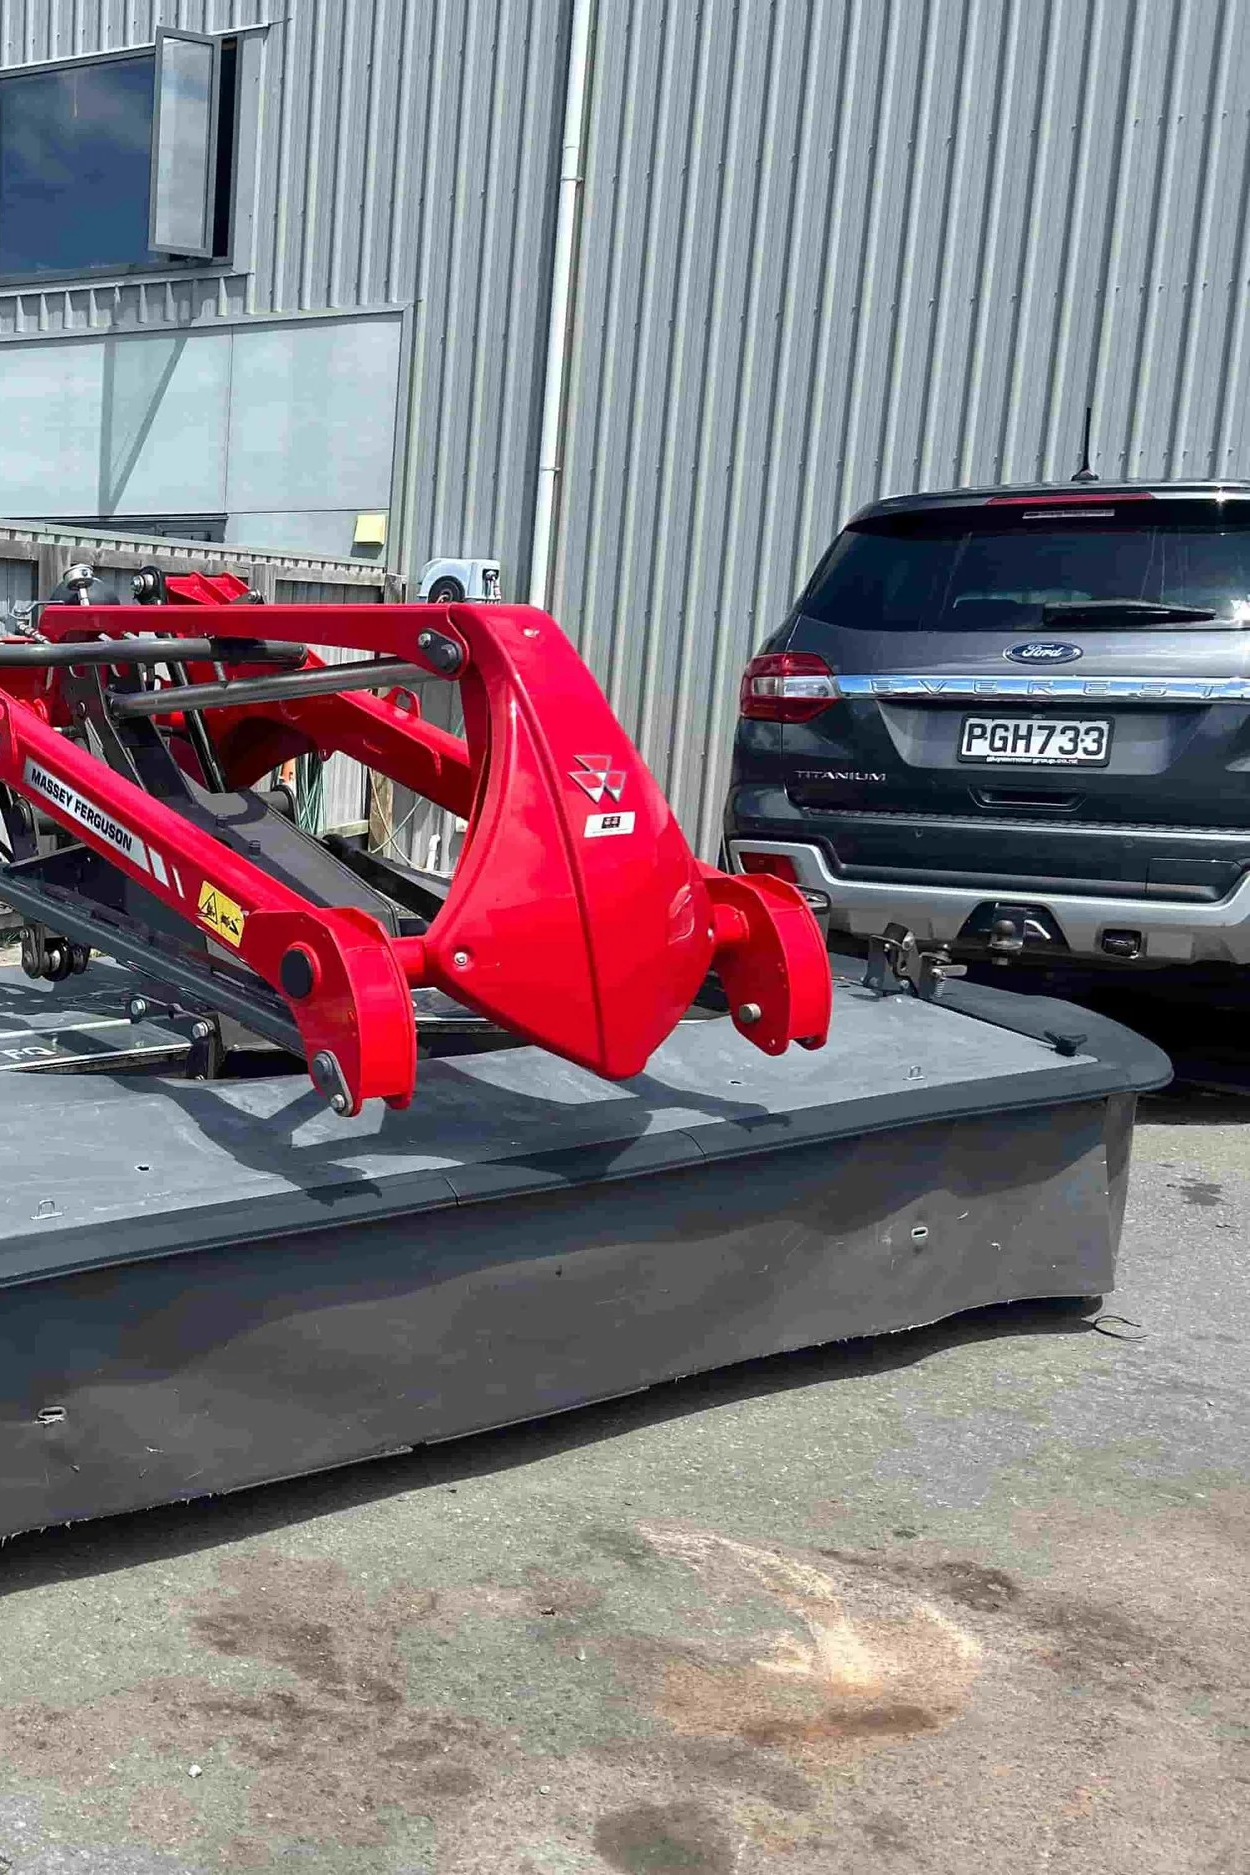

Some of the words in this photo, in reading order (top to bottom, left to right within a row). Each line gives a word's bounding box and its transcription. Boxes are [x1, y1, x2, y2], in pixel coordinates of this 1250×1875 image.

[1021, 644, 1064, 657] Ford
[869, 679, 1225, 698] EVEREST
[965, 723, 1105, 756] PGH733
[793, 769, 886, 781] TITANIUM
[31, 768, 72, 808] MASSEY
[74, 798, 133, 851] FERGUSON
